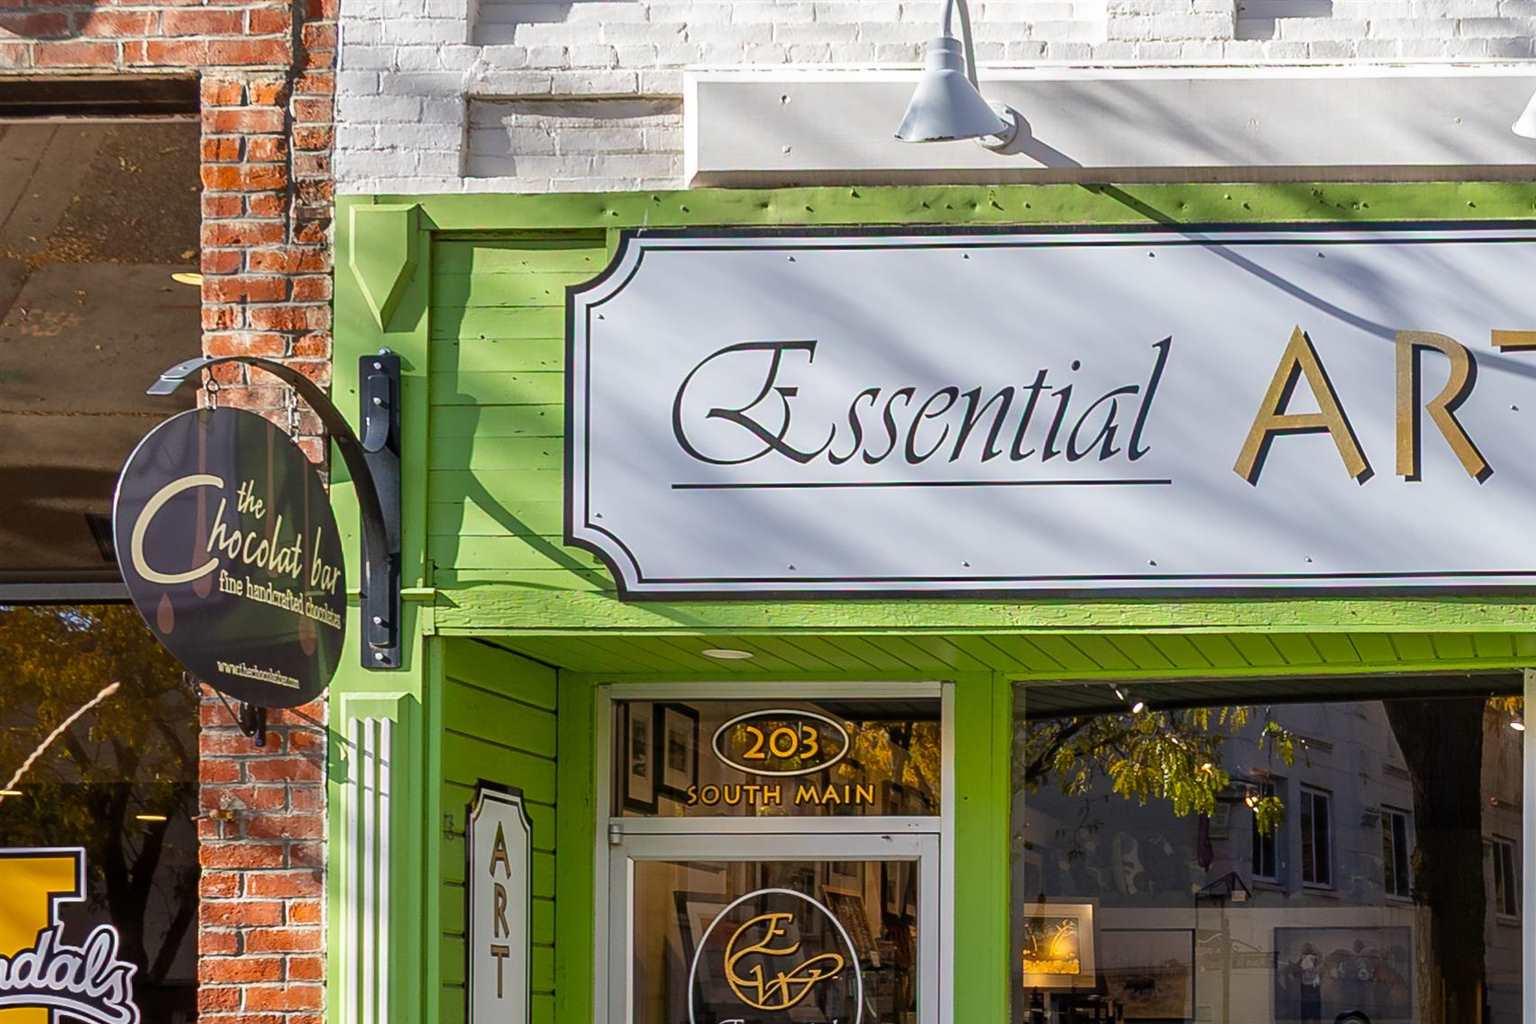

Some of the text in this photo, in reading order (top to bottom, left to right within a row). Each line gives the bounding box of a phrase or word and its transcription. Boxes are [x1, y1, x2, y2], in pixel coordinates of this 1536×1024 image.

[671, 335, 1173, 465] Essential
[236, 479, 266, 519] the
[131, 474, 341, 595] Chocolat bar
[219, 569, 244, 596] fine
[246, 576, 305, 616] handcrafted
[743, 725, 819, 760] 203
[686, 783, 876, 806] SOUTH MAIN
[489, 820, 512, 999] ART
